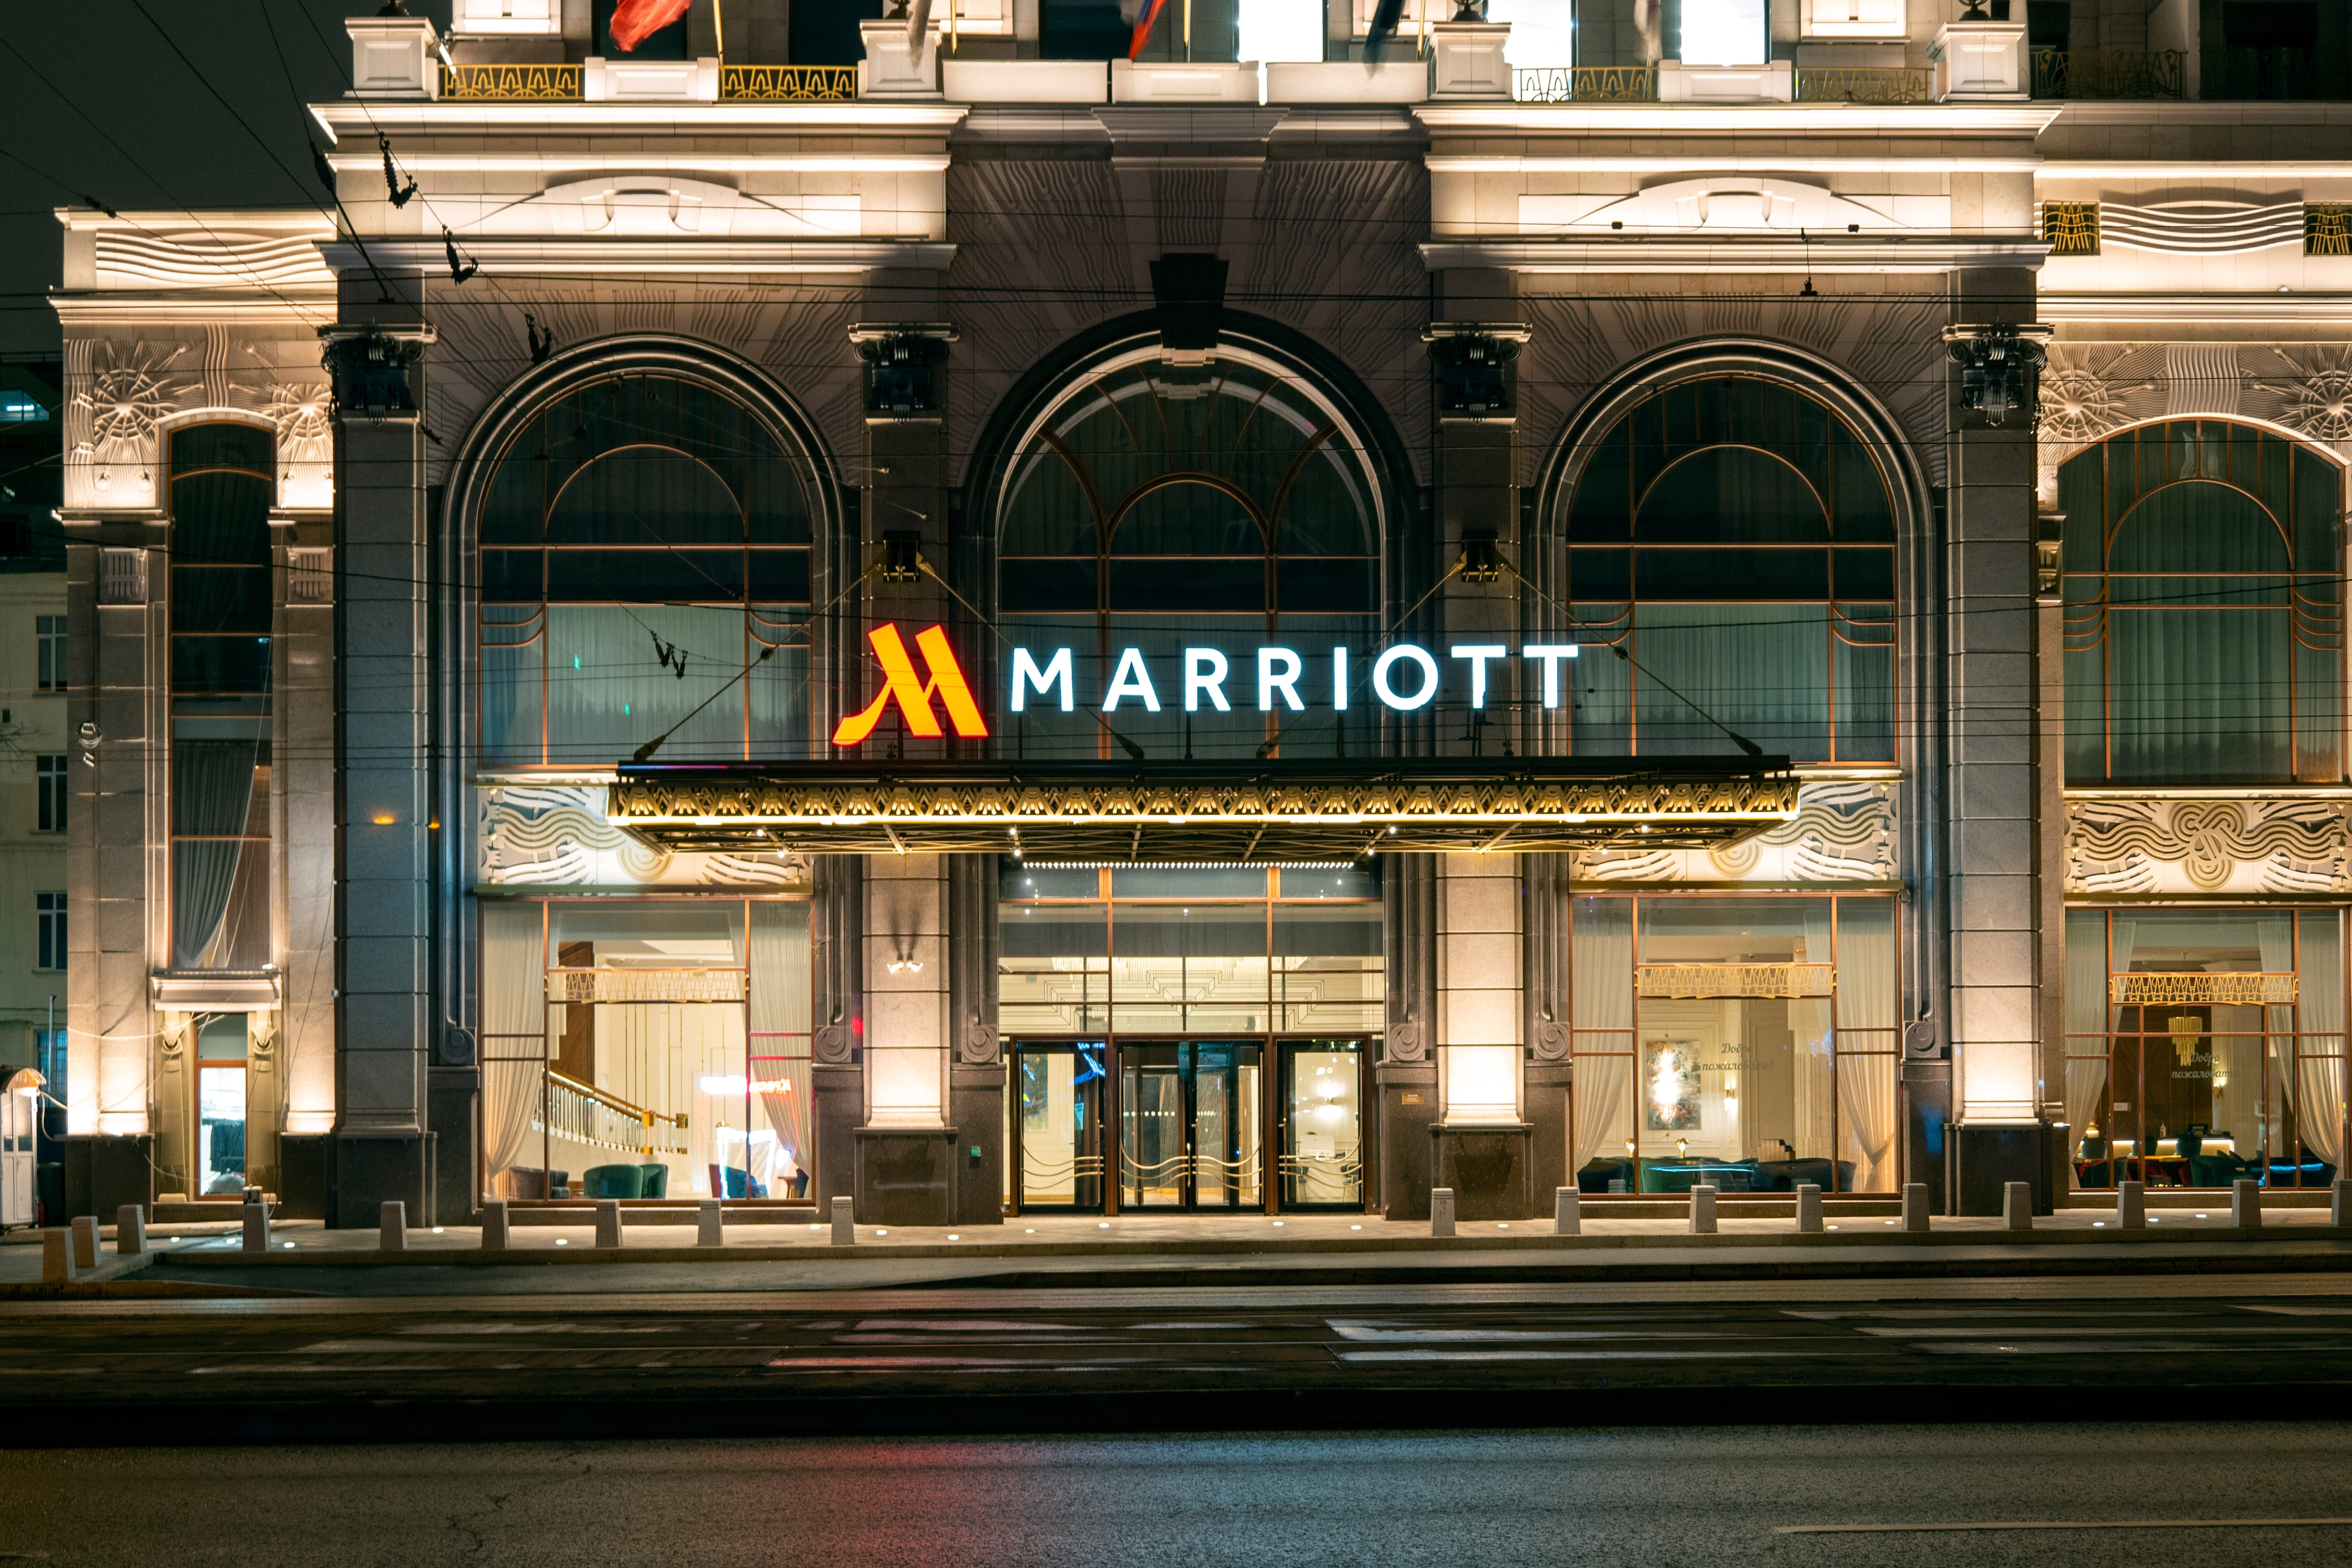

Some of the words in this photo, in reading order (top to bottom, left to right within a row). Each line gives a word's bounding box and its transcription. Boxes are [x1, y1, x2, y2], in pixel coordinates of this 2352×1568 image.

[1010, 644, 1579, 712] MARRIOTT
[1721, 1043, 1754, 1058] Добро
[2190, 1052, 2220, 1066] Добро
